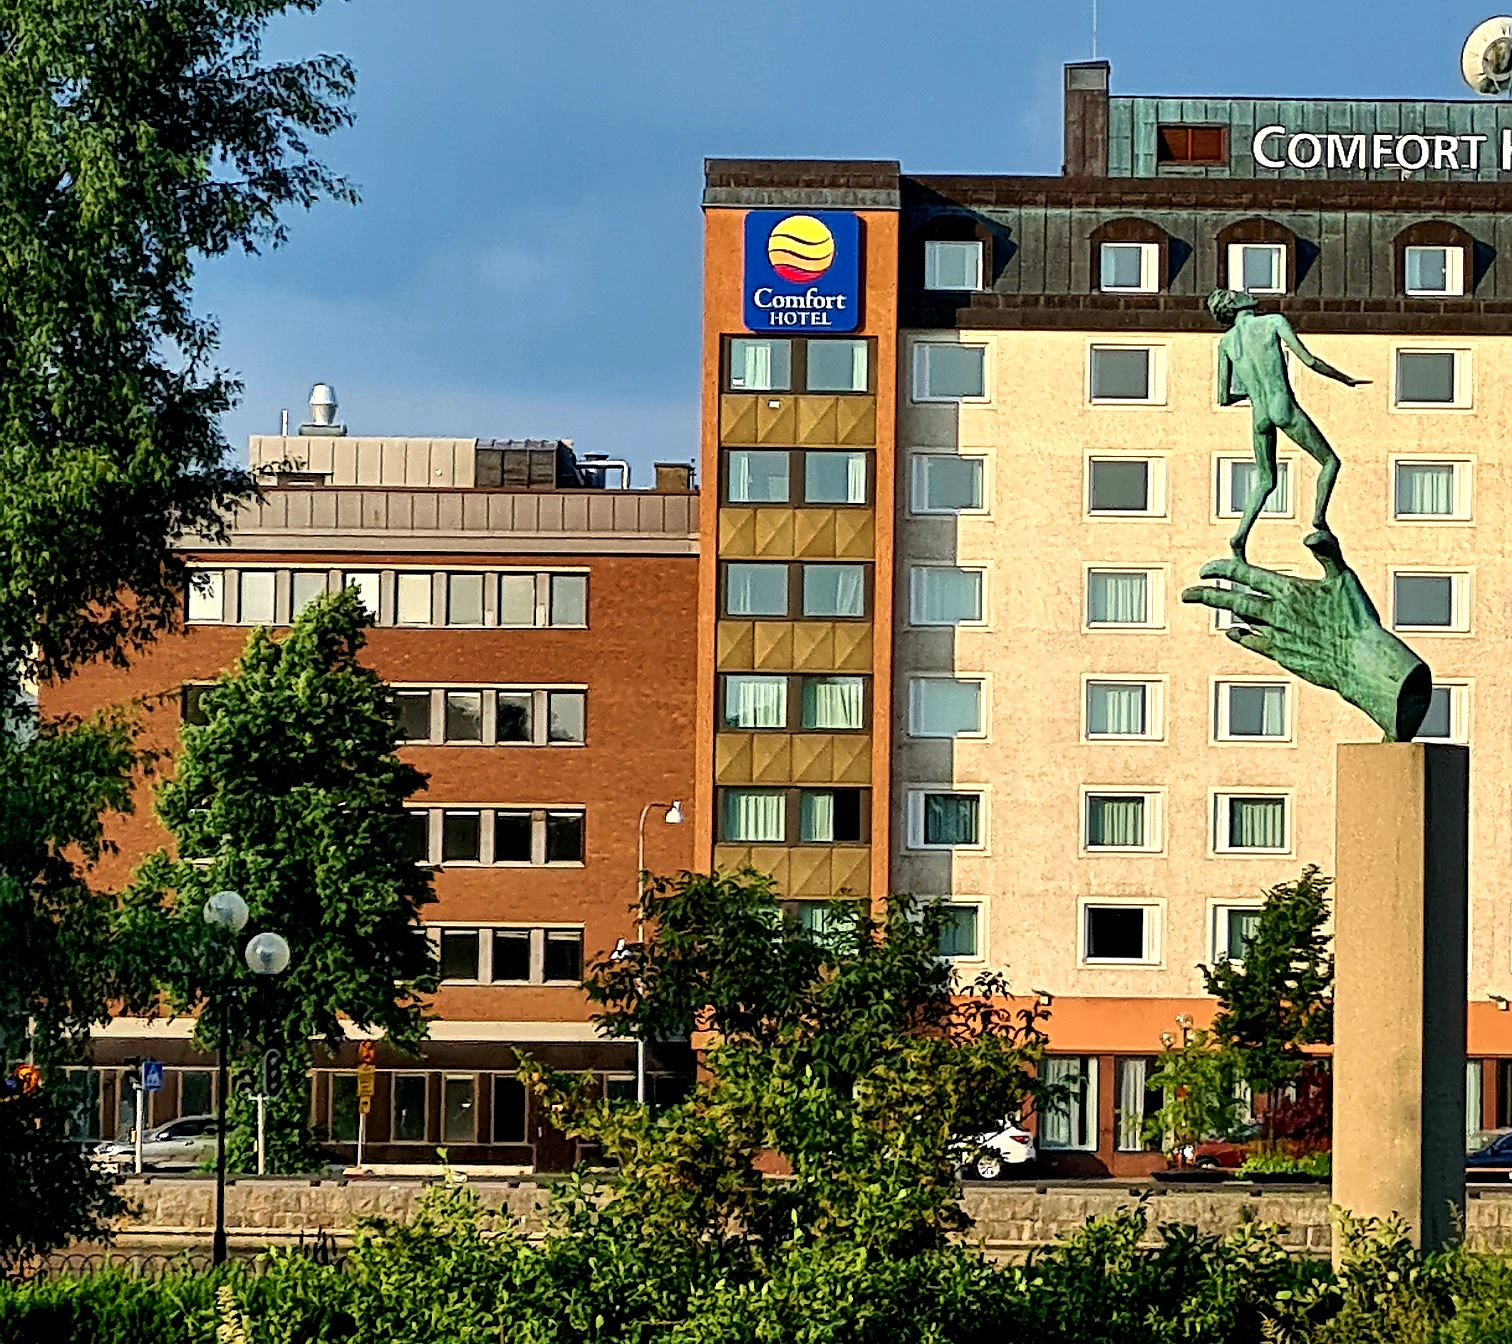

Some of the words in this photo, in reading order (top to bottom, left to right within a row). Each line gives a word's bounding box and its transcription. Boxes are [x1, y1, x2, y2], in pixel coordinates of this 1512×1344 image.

[1252, 124, 1488, 171] COMFORT
[754, 287, 847, 309] Comfort
[769, 311, 832, 326] HOTEL
